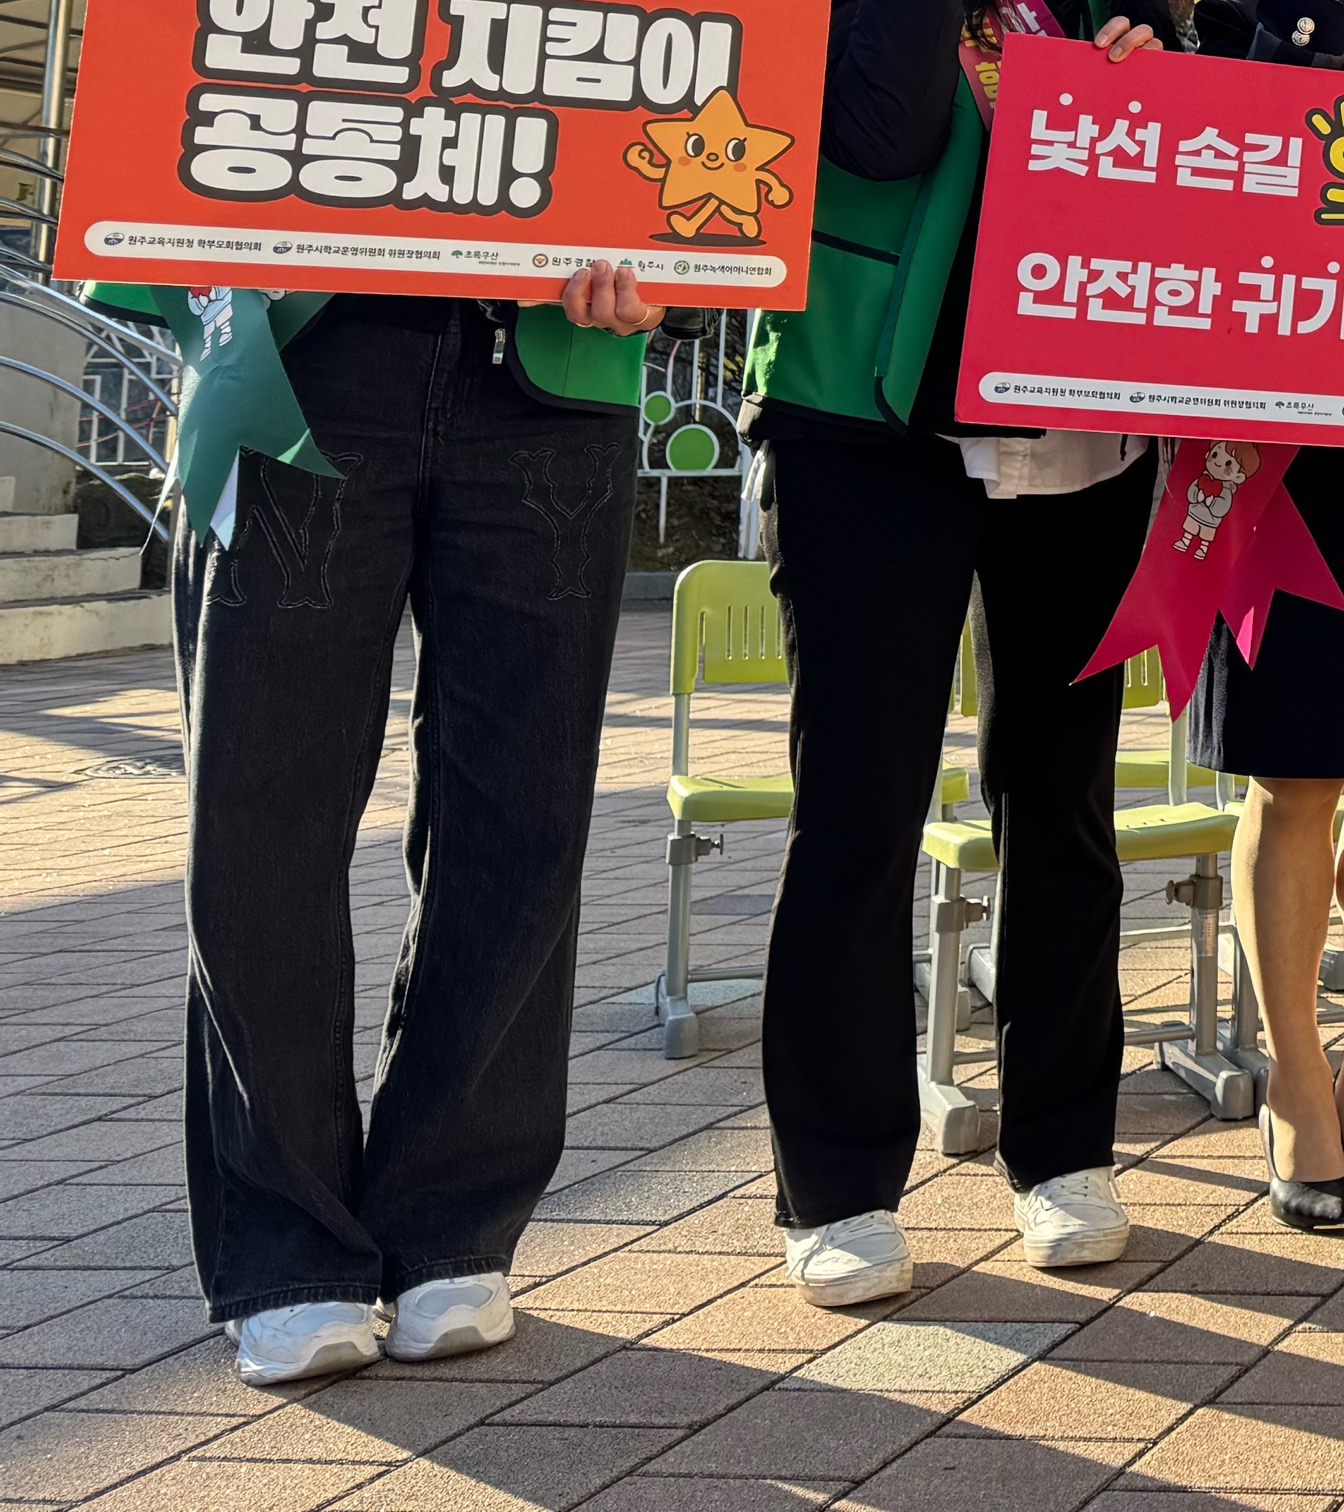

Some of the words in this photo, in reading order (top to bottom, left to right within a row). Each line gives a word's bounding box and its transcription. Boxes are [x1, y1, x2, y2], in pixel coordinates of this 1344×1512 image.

[188, 93, 547, 210] 공동체!
[1027, 92, 1162, 183] 낯선
[1174, 125, 1303, 197] 손길
[127, 235, 195, 249] 원주교육지원청
[637, 260, 664, 272] 원주시
[1016, 252, 1222, 330] 안전한
